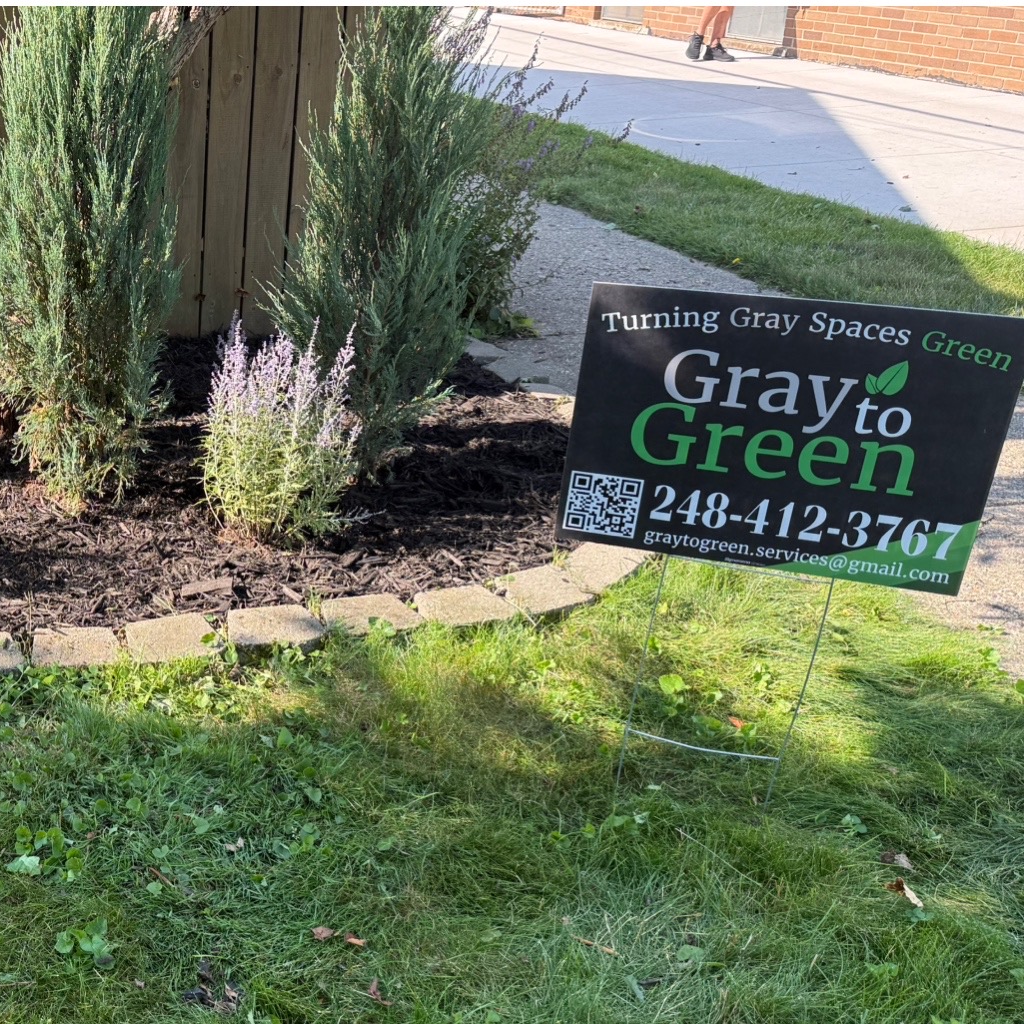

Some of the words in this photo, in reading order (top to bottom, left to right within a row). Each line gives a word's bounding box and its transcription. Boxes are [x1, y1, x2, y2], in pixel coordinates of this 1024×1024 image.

[601, 306, 720, 334] Turning
[730, 307, 801, 335] Gray
[809, 311, 911, 346] Spaces
[921, 330, 1012, 372] Green
[664, 349, 859, 434] Gray
[855, 397, 912, 438] to
[630, 402, 915, 496] Green
[643, 530, 950, 584] graytogreen.services@gmail.com
[649, 485, 963, 560] 248-412-3767
